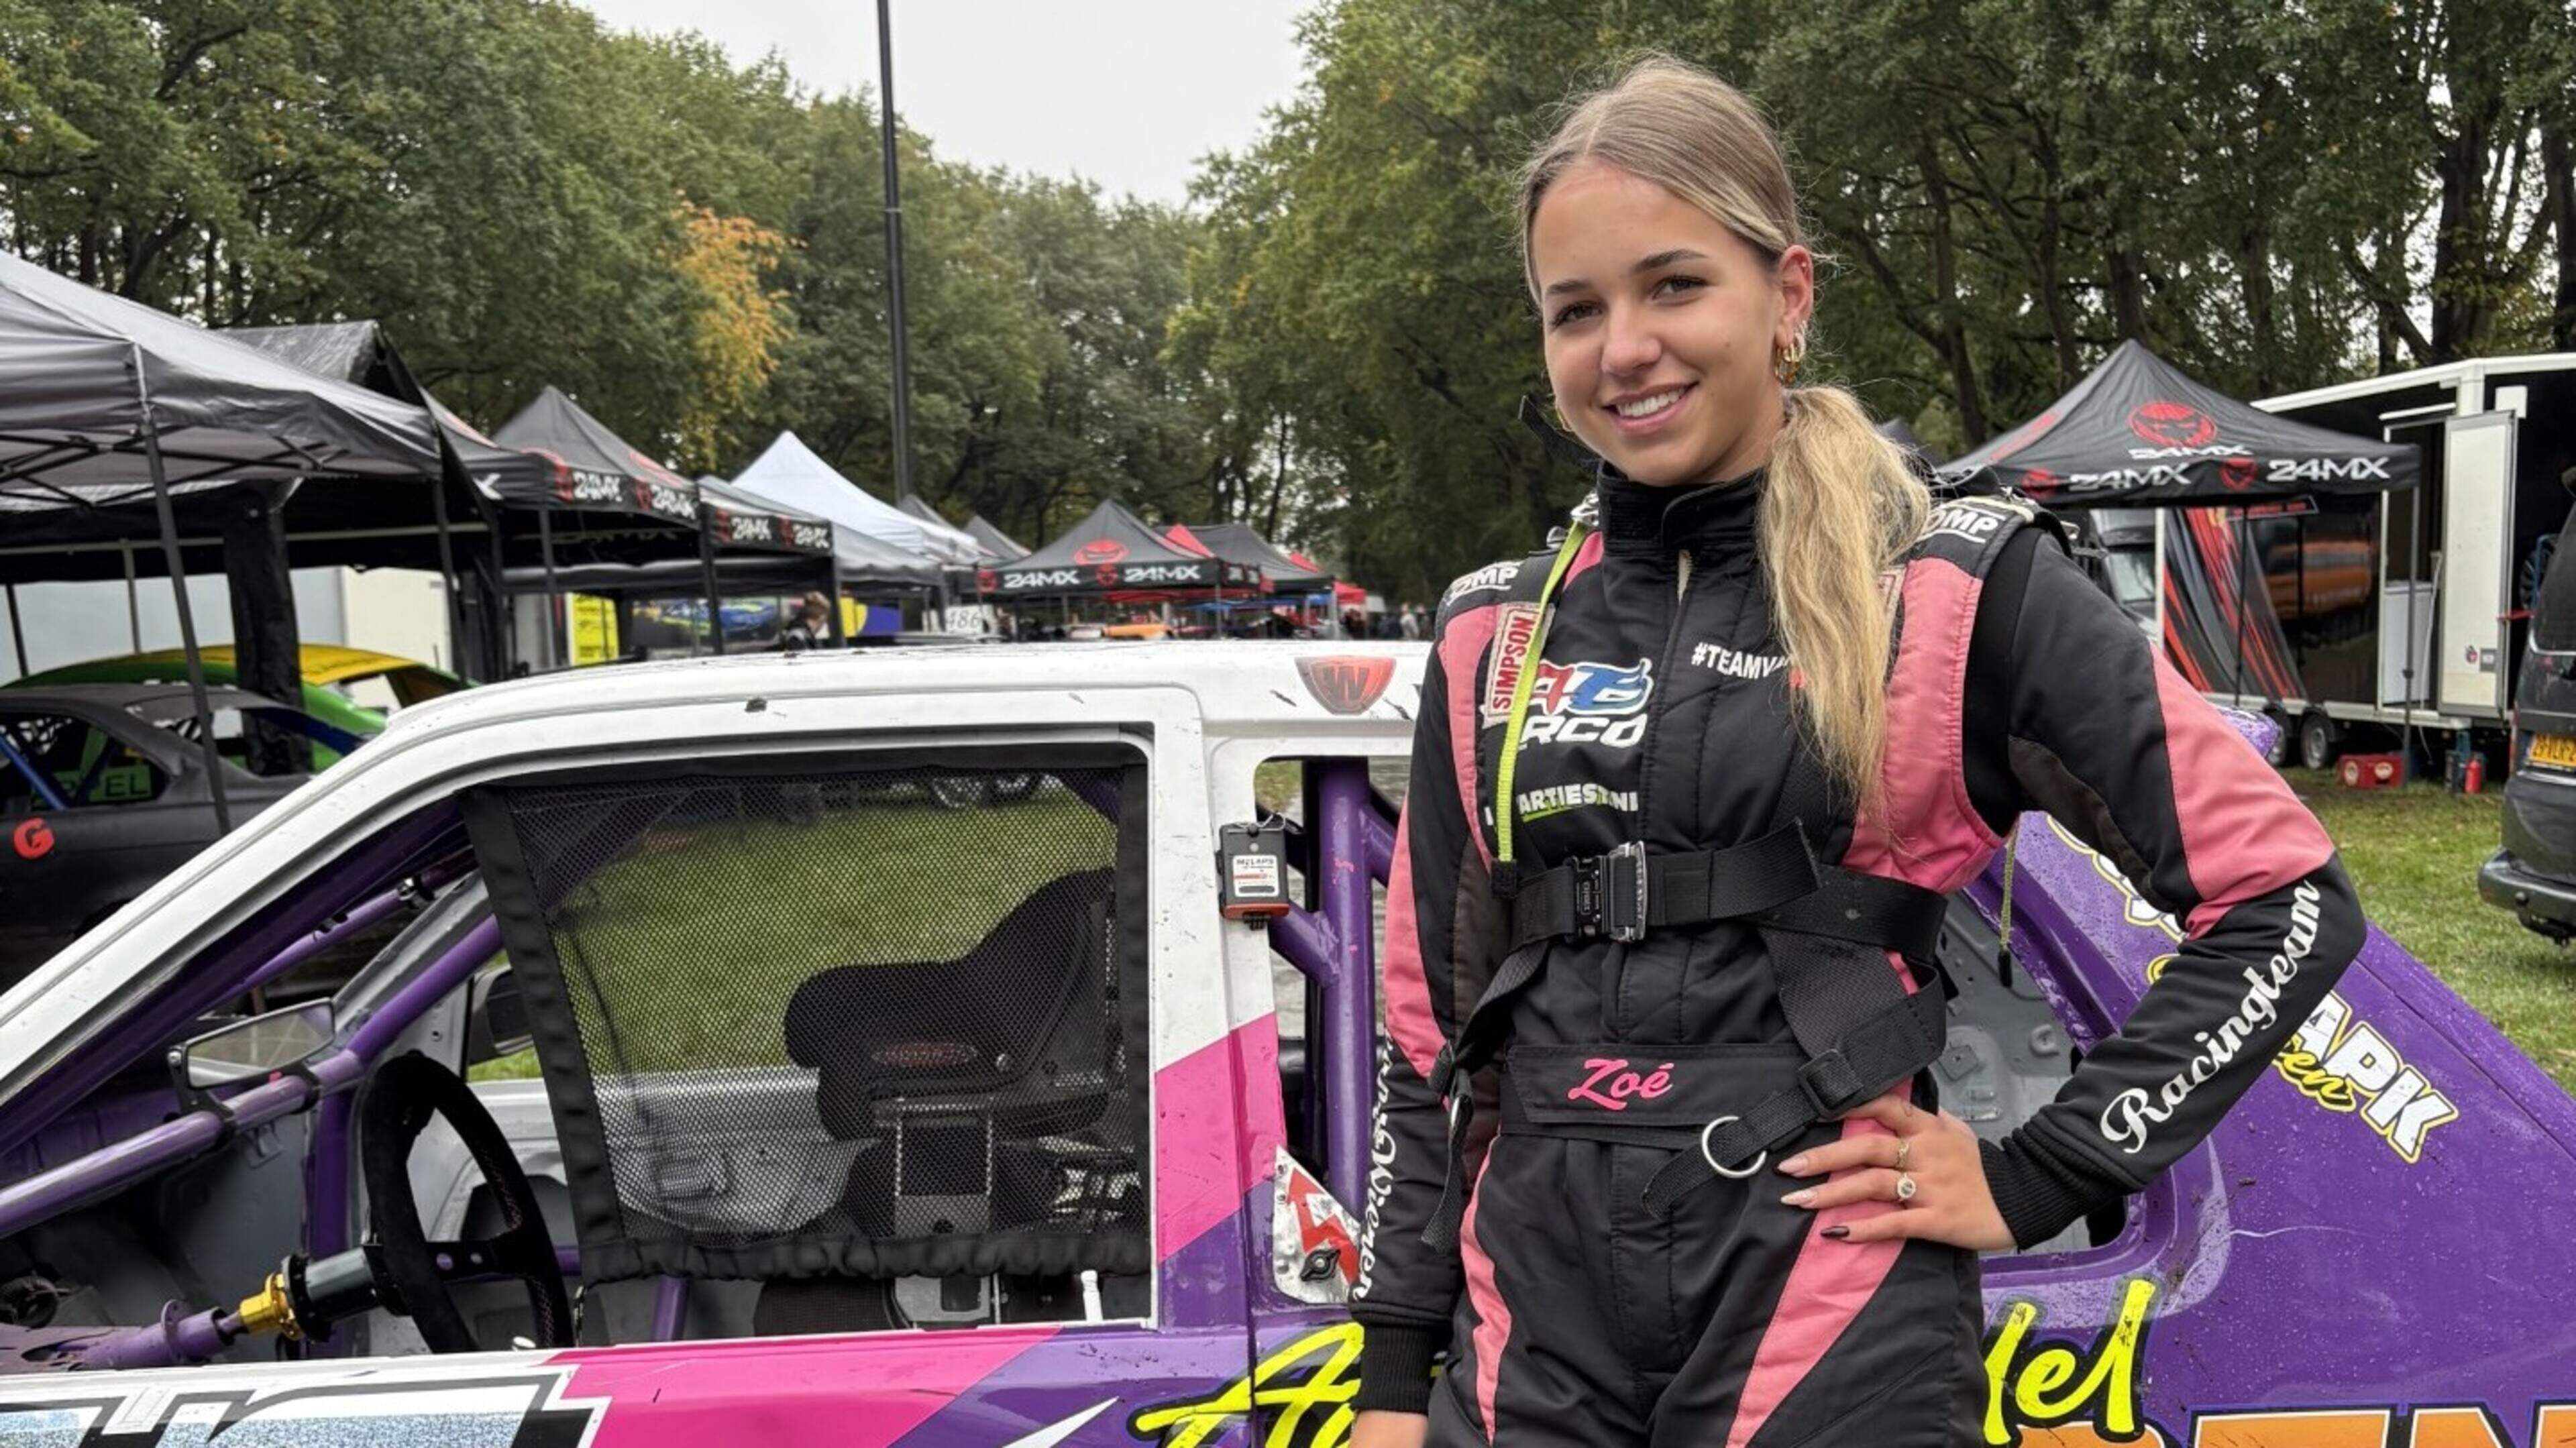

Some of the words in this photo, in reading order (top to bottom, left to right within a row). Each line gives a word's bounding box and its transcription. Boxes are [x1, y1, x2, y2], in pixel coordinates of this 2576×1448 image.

[2069, 462, 2192, 492] 24MX
[2267, 457, 2390, 482] 24MX
[1003, 569, 1080, 589] 24MX
[1124, 565, 1201, 583] 24MX
[1492, 615, 1538, 710] SIMPSON
[2098, 879, 2322, 1154] Racingteam
[1567, 1058, 1674, 1111] Zoé
